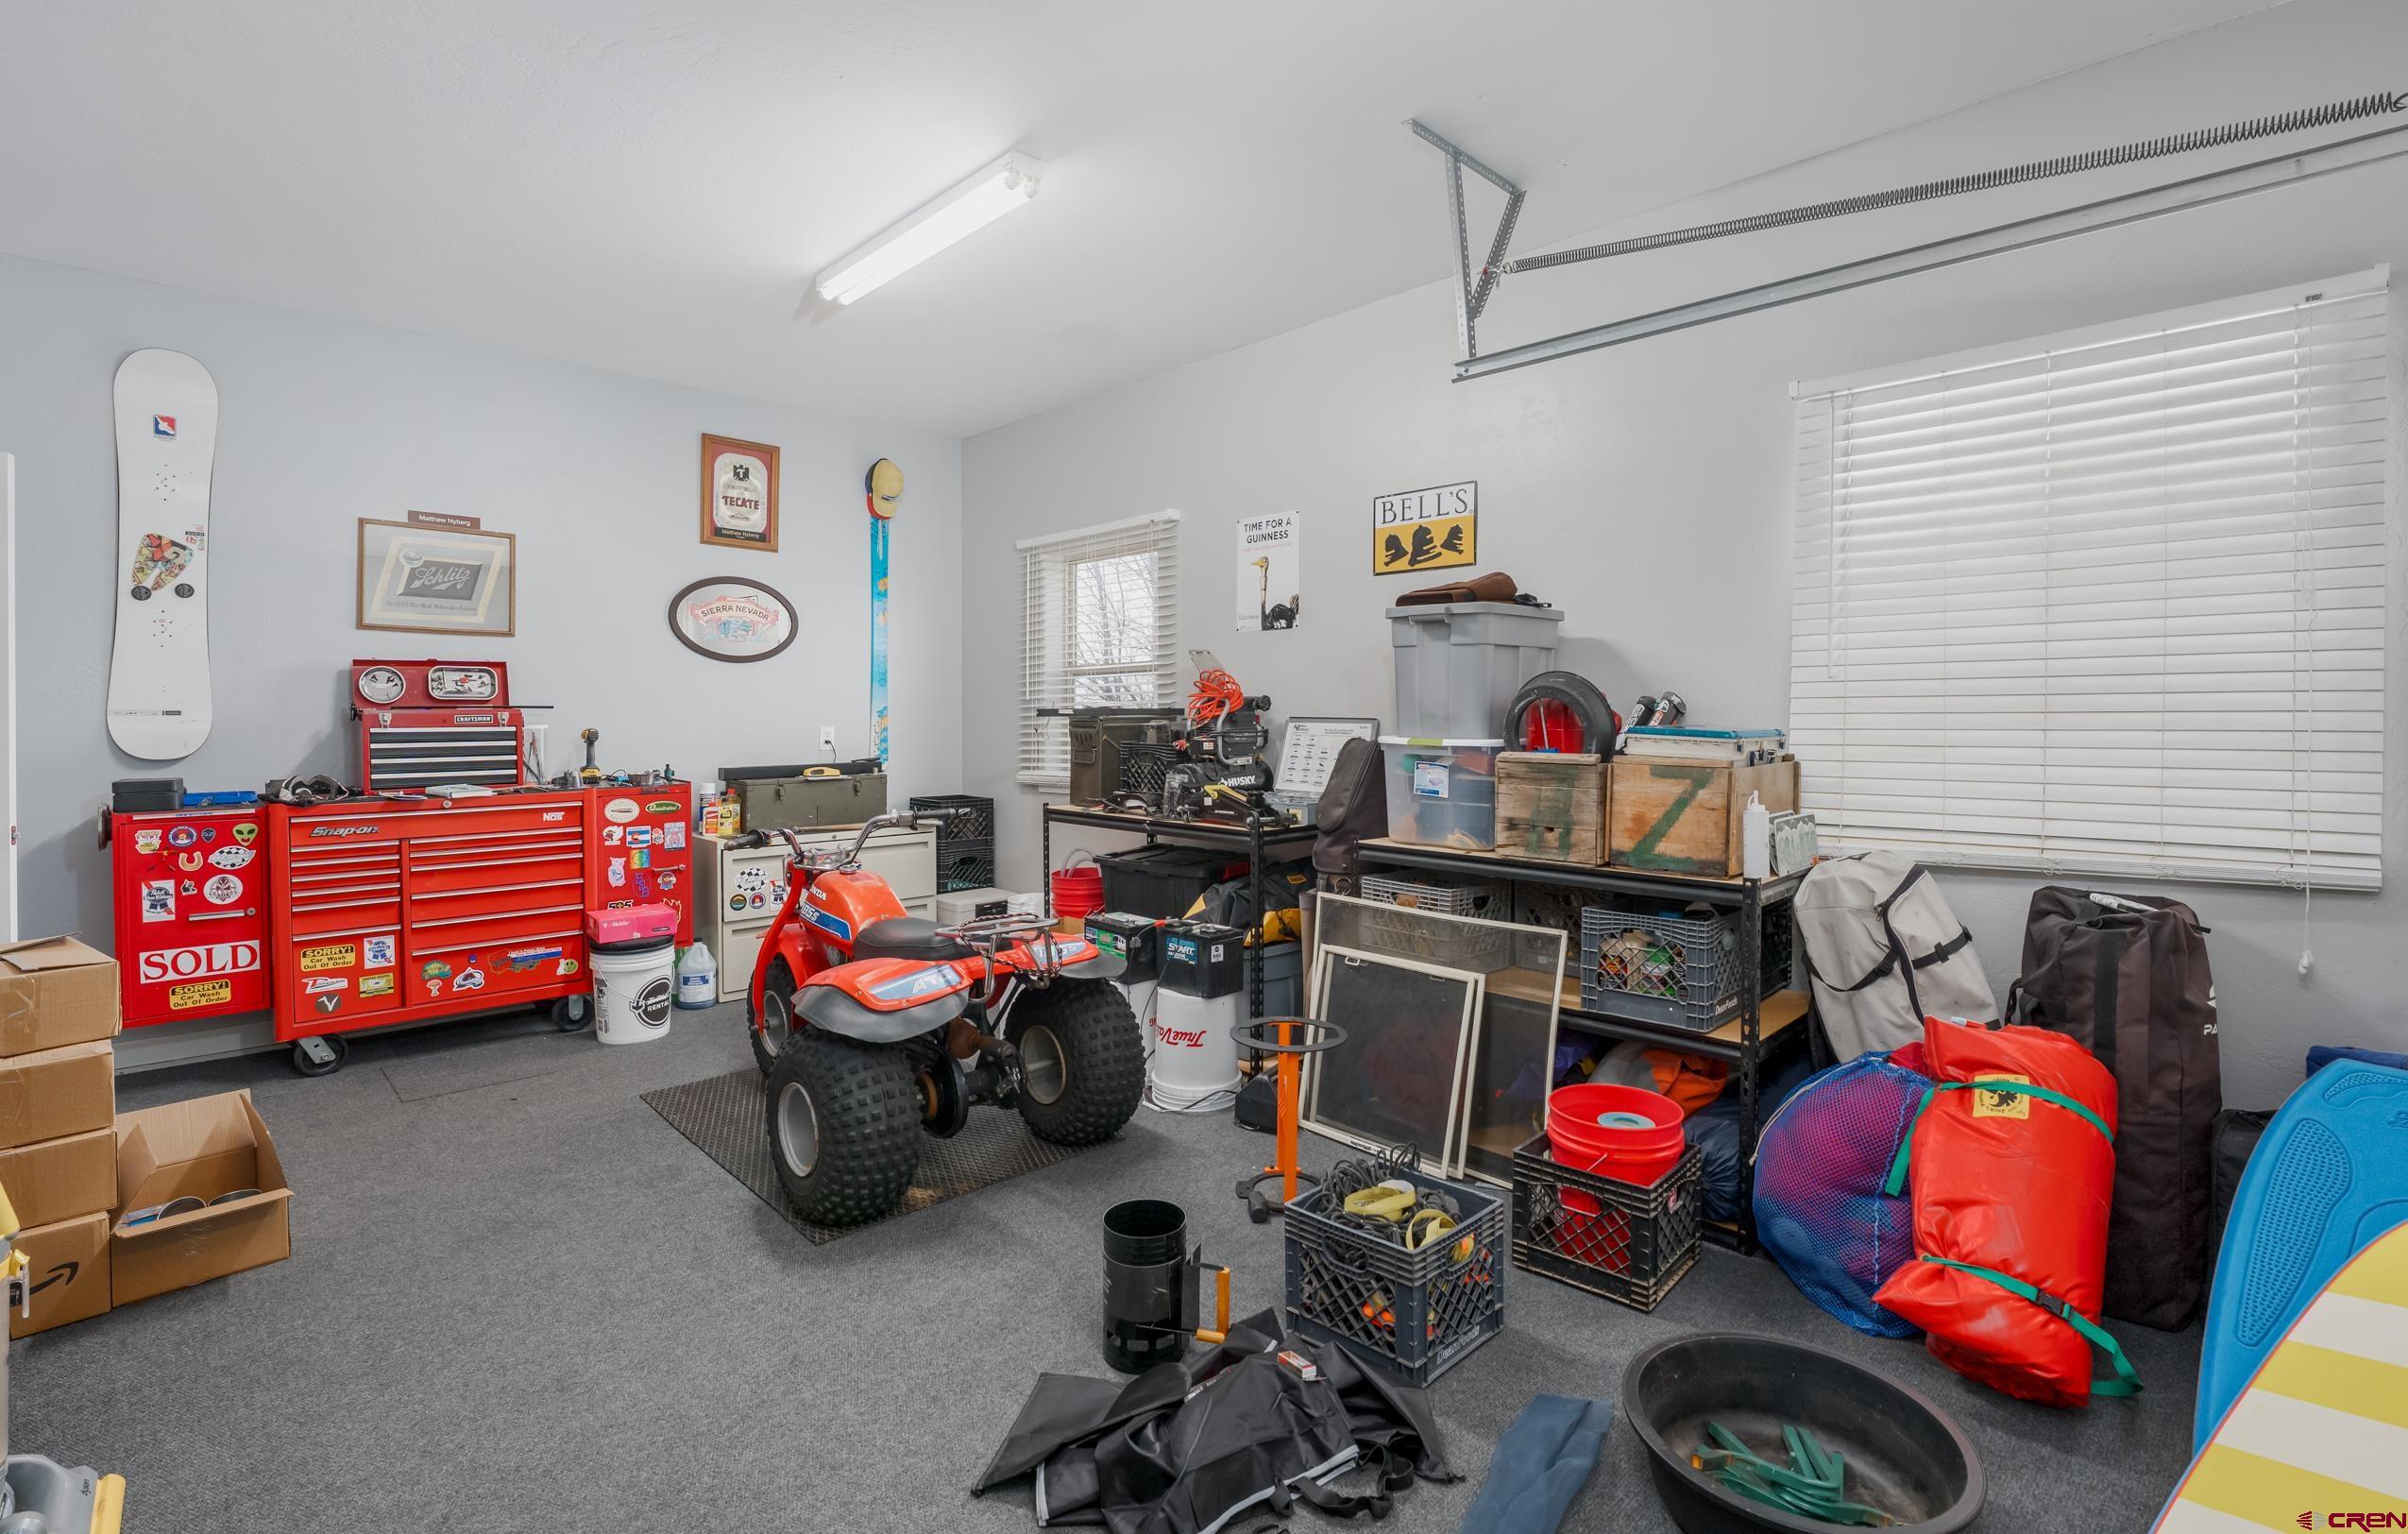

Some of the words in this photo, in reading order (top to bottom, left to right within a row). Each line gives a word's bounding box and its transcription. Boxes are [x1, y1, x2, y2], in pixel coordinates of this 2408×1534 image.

[721, 495, 760, 510] TECATE
[1381, 487, 1469, 524] BELL'S
[418, 514, 447, 523] Matthew
[448, 517, 471, 527] Nyberg
[1244, 520, 1263, 533] TIME
[1265, 518, 1283, 530] FOR
[1285, 517, 1292, 526] A
[1246, 529, 1289, 544] GUINNESS
[409, 566, 471, 590] Schlitz
[701, 605, 734, 618] SIERRA
[735, 605, 770, 621] NEVADA
[1228, 775, 1256, 787] HUSKY
[310, 825, 380, 838] Snap-on
[305, 946, 351, 959] SORRY!
[144, 944, 258, 981] SOLD
[171, 980, 228, 996] SORRY!
[200, 991, 221, 999] Wash
[206, 995, 228, 1003] Order
